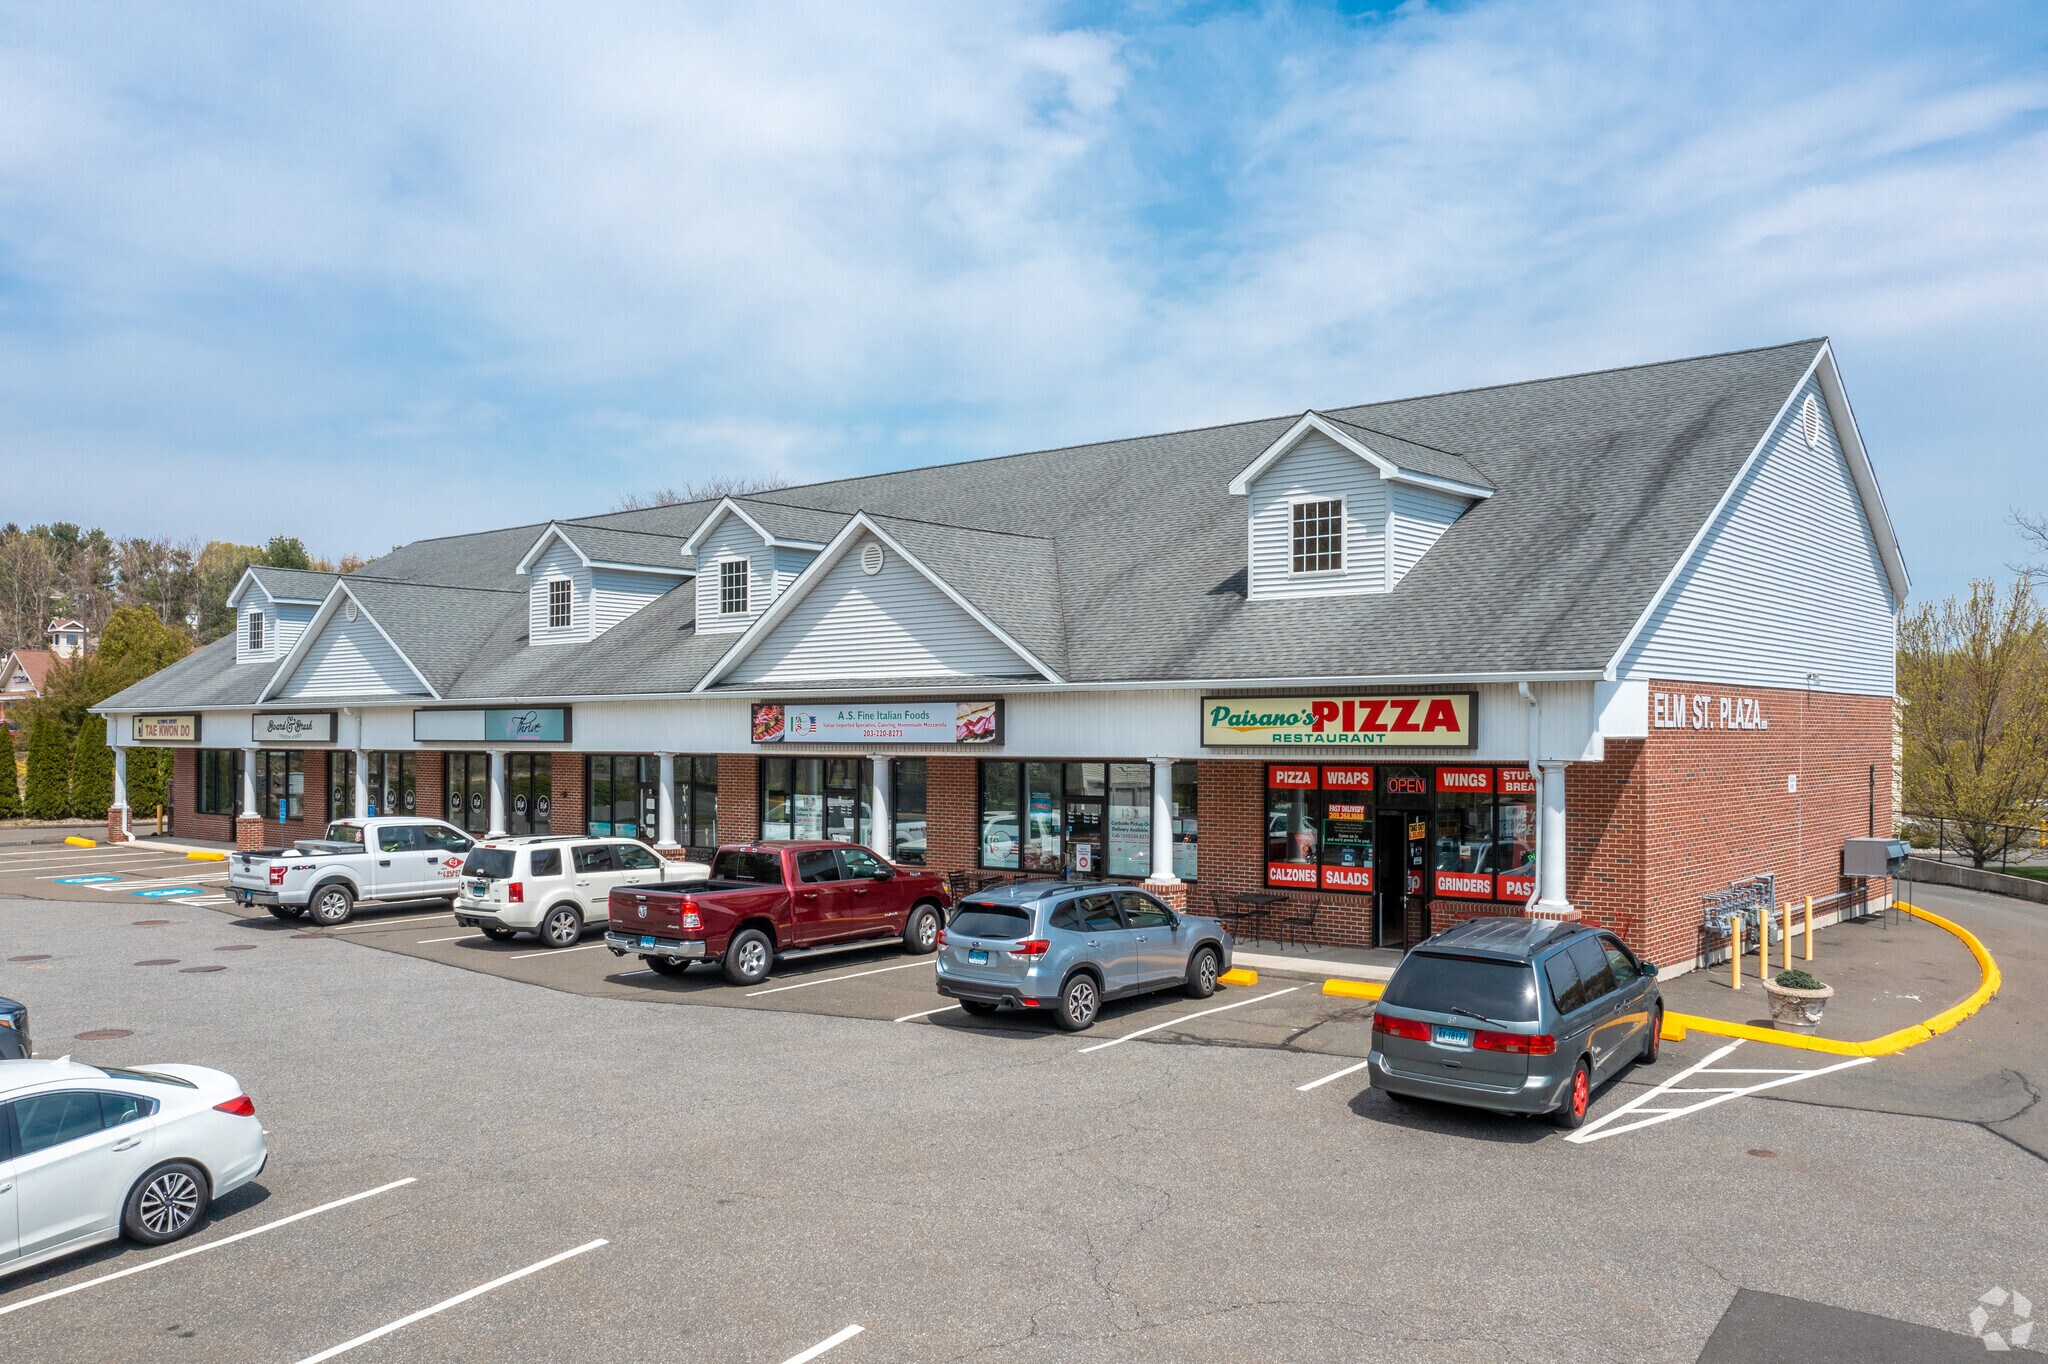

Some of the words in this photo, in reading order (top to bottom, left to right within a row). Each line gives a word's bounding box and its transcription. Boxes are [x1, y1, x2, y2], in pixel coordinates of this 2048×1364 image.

[857, 711, 875, 720] Fine
[877, 710, 902, 720] Italian
[904, 710, 930, 720] Foods
[1210, 706, 1319, 727] Paisano's
[1312, 699, 1461, 732] PIZZA
[1654, 693, 1686, 728] ELM
[1692, 694, 1714, 730] ST.
[1720, 697, 1761, 730] PLAZA
[267, 720, 287, 732] Board
[294, 719, 313, 732] Brush
[512, 711, 541, 733] Thrive
[145, 725, 157, 737] TAE
[159, 725, 178, 737] KWON
[181, 725, 190, 737] DO
[1272, 733, 1386, 743] RESTAURANT
[1276, 771, 1311, 784] PIZZA
[1327, 772, 1369, 785] WRAPS
[1443, 773, 1487, 787] WINGS
[1503, 771, 1535, 780] STUF
[1389, 779, 1425, 793] OPEN
[1269, 868, 1317, 882] CALZONES
[1326, 871, 1369, 886] SALADS
[1438, 877, 1491, 893] GRINDERS
